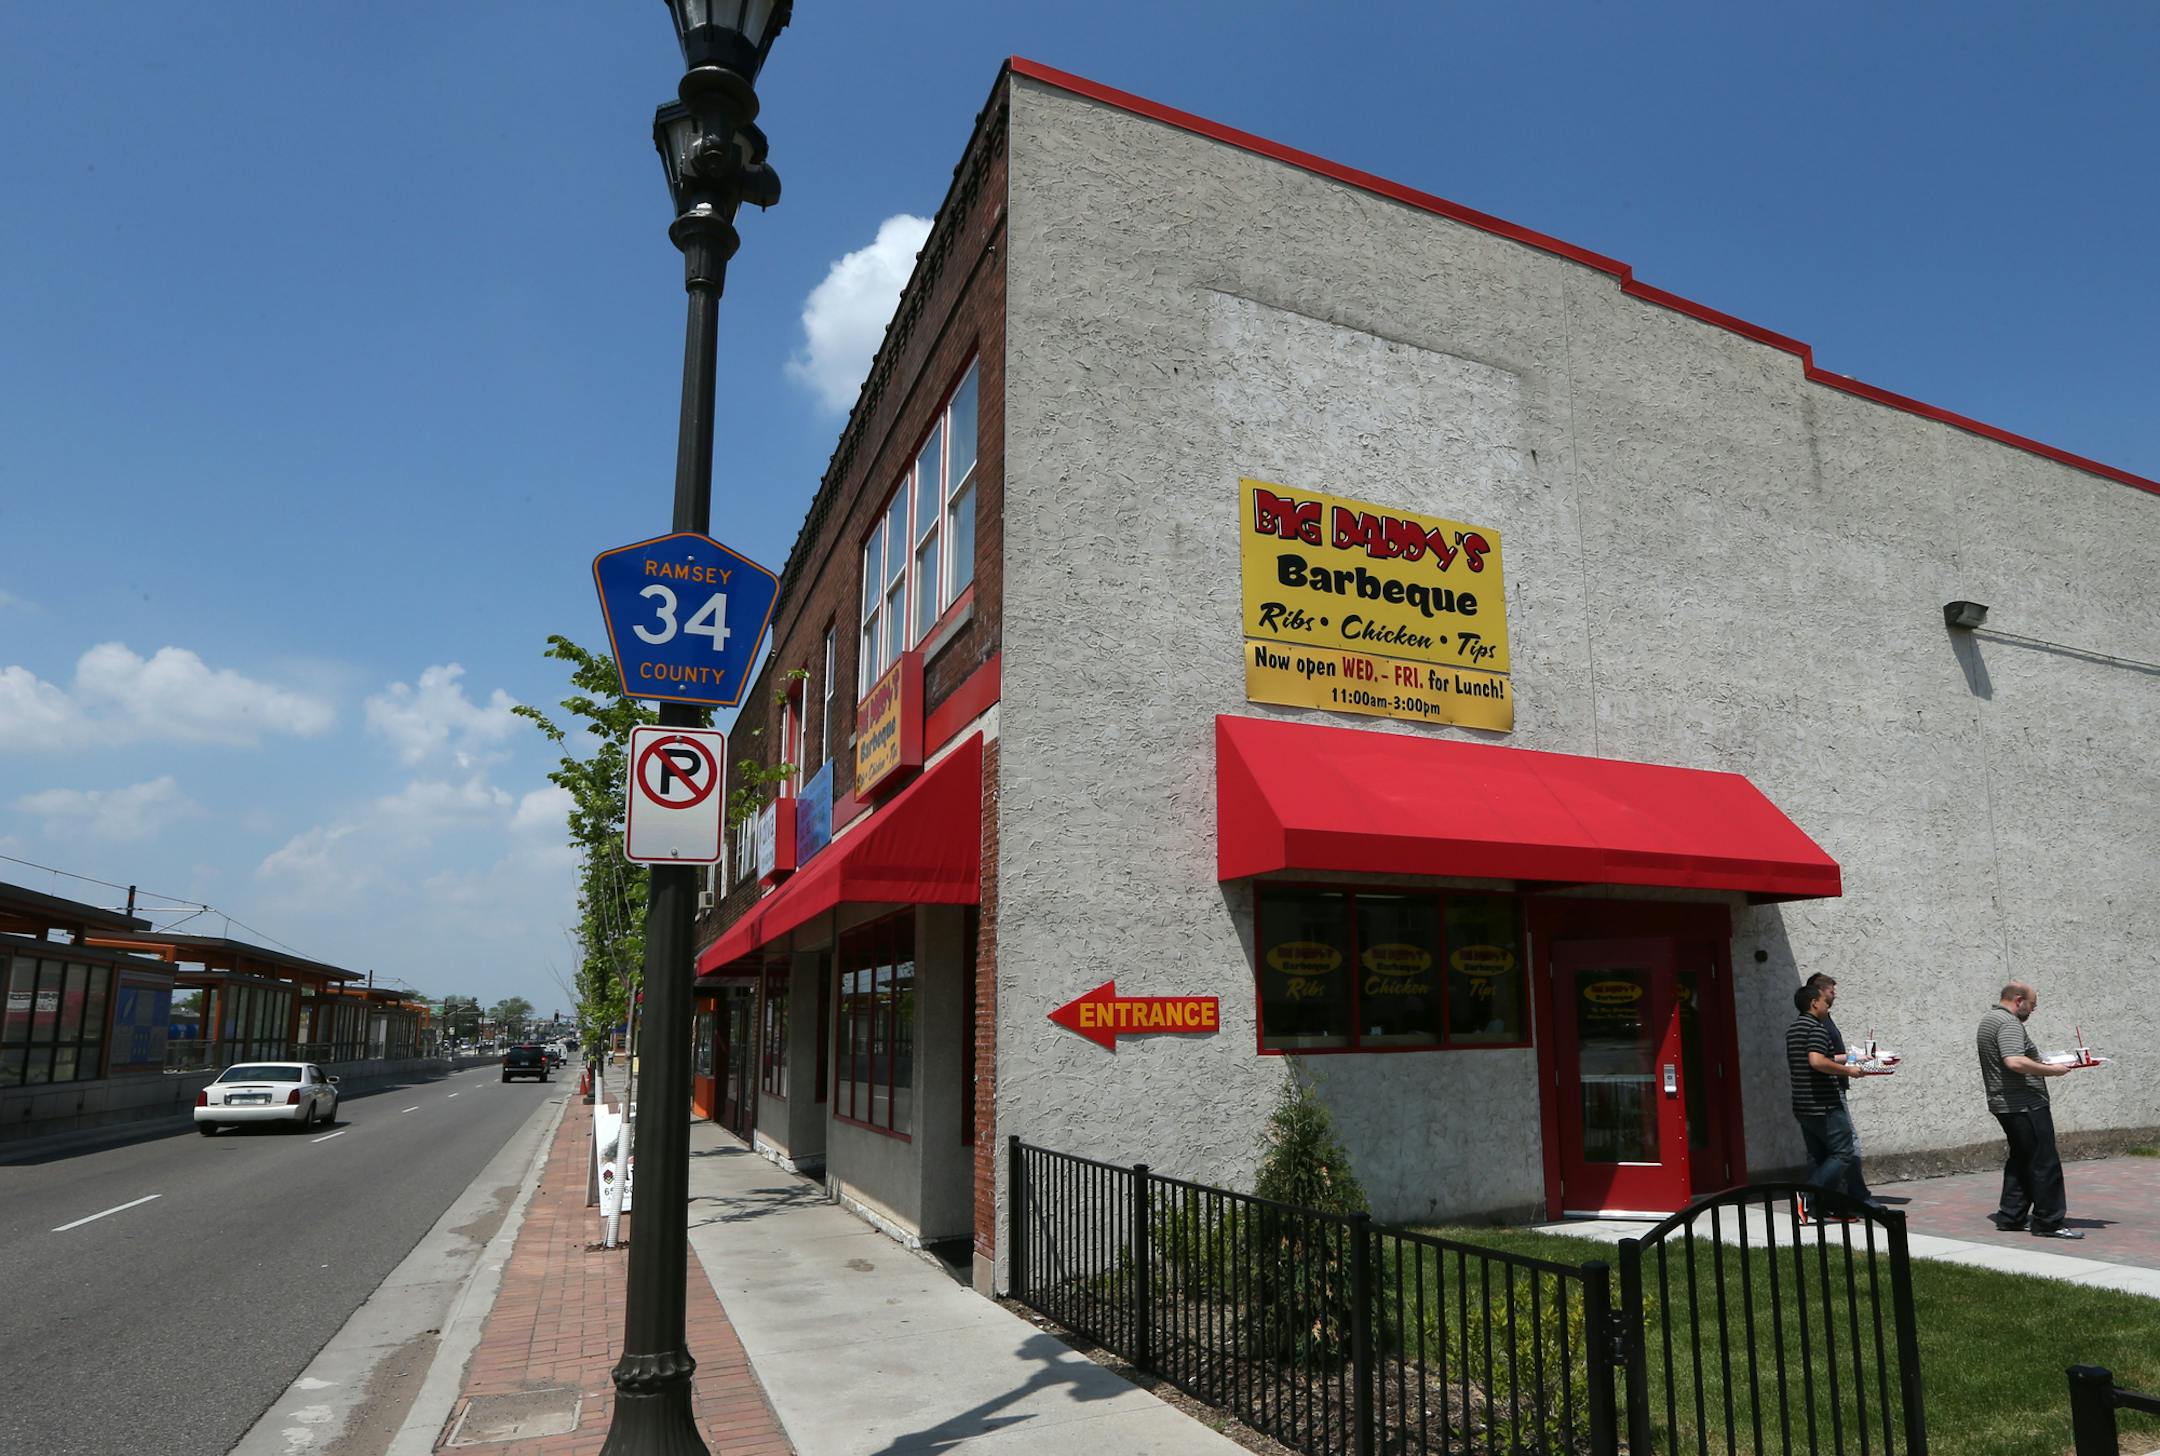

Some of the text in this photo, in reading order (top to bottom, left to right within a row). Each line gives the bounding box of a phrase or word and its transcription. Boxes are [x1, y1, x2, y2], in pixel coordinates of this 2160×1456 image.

[1252, 487, 1491, 573] BIG DADDY'S
[645, 560, 733, 585] RAMSEY
[1276, 553, 1478, 618] Barbeque
[632, 584, 732, 652] 34
[1258, 602, 1497, 664] Ribs Chicken Tips
[640, 662, 725, 685] COUNTY
[1254, 646, 1290, 670] Now
[1296, 657, 1336, 680] open
[1394, 665, 1424, 689] FRI.
[1428, 669, 1449, 692] for
[1455, 674, 1504, 699] Lunch!
[1079, 1002, 1216, 1027] ENTRANCE
